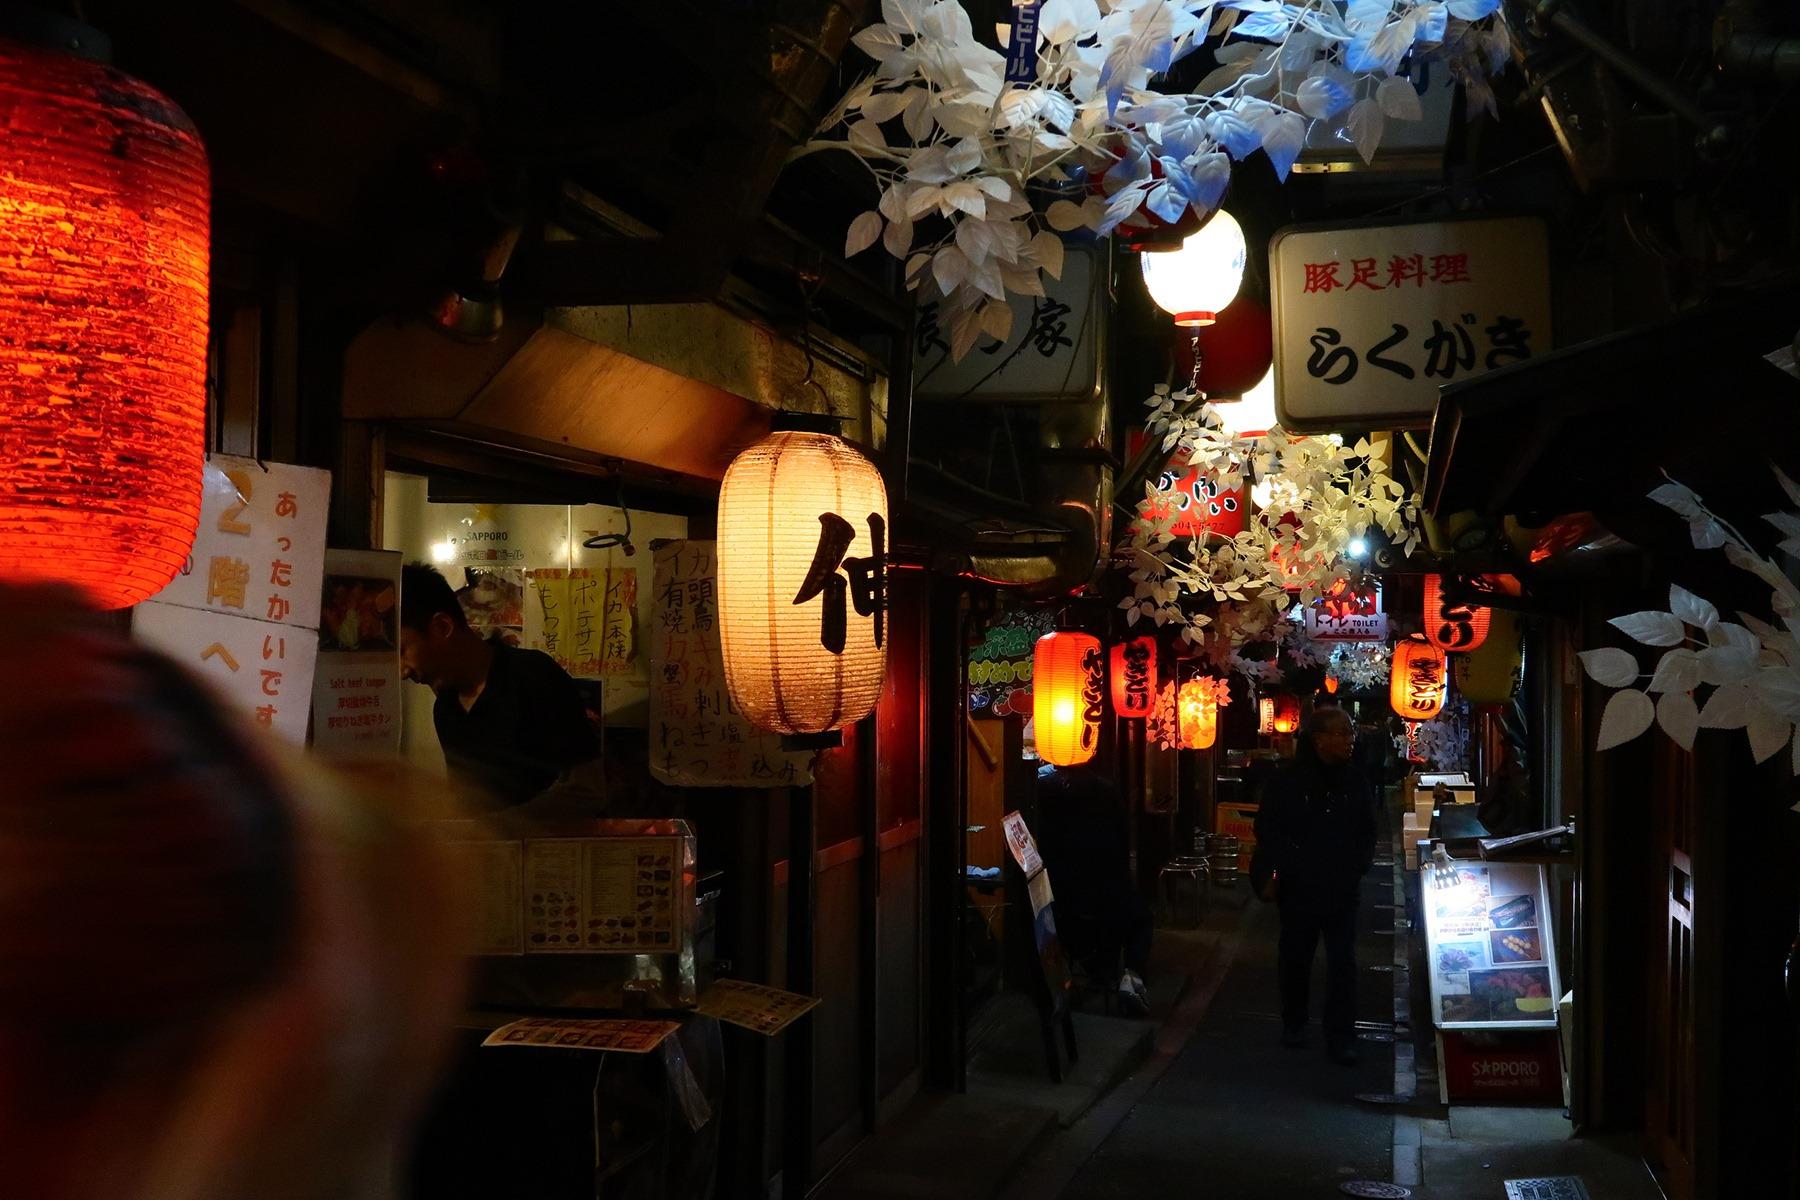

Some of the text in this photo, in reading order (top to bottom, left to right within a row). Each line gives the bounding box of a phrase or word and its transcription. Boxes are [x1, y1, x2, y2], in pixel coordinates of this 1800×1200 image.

[1303, 252, 1472, 295] 豚足料理
[1308, 313, 1533, 387] らくがき
[466, 531, 509, 542] SAPPORO
[254, 490, 298, 728] あったかいです
[574, 580, 598, 664] ポテサラ
[1315, 616, 1379, 628] トイレ TOILET
